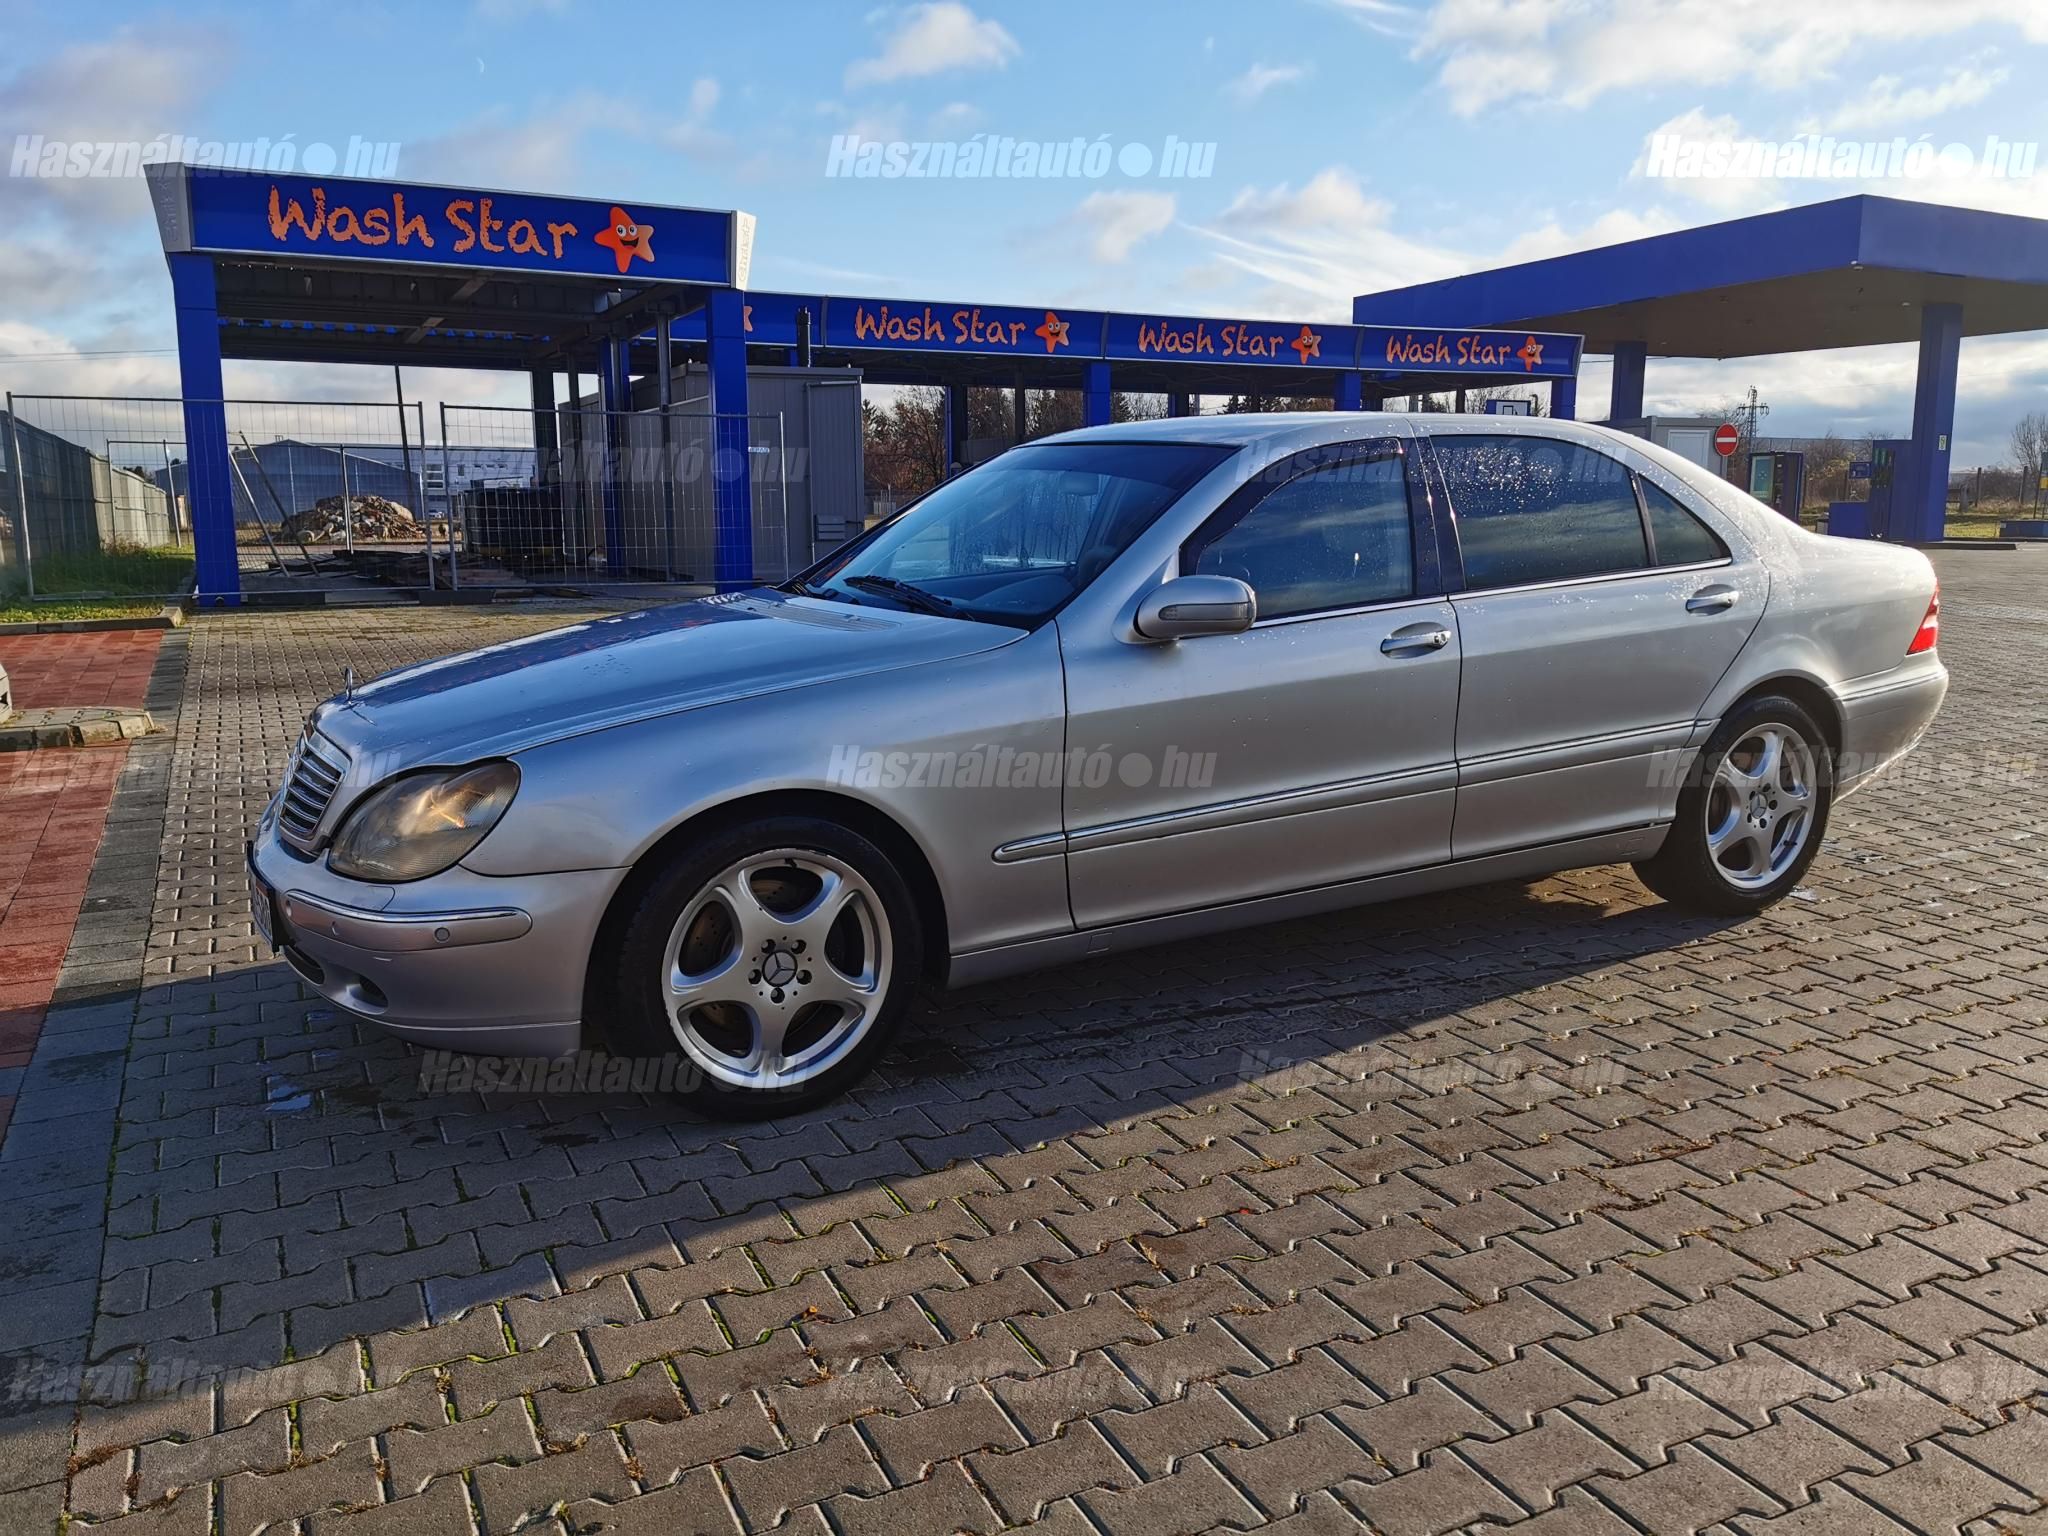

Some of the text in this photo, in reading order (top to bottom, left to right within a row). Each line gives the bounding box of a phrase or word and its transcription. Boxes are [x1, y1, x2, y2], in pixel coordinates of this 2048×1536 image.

[268, 185, 577, 259] Wash Star
[855, 306, 1026, 346] Wash Star
[1138, 321, 1284, 358] Wash Star
[1387, 335, 1511, 365] Wash Star
